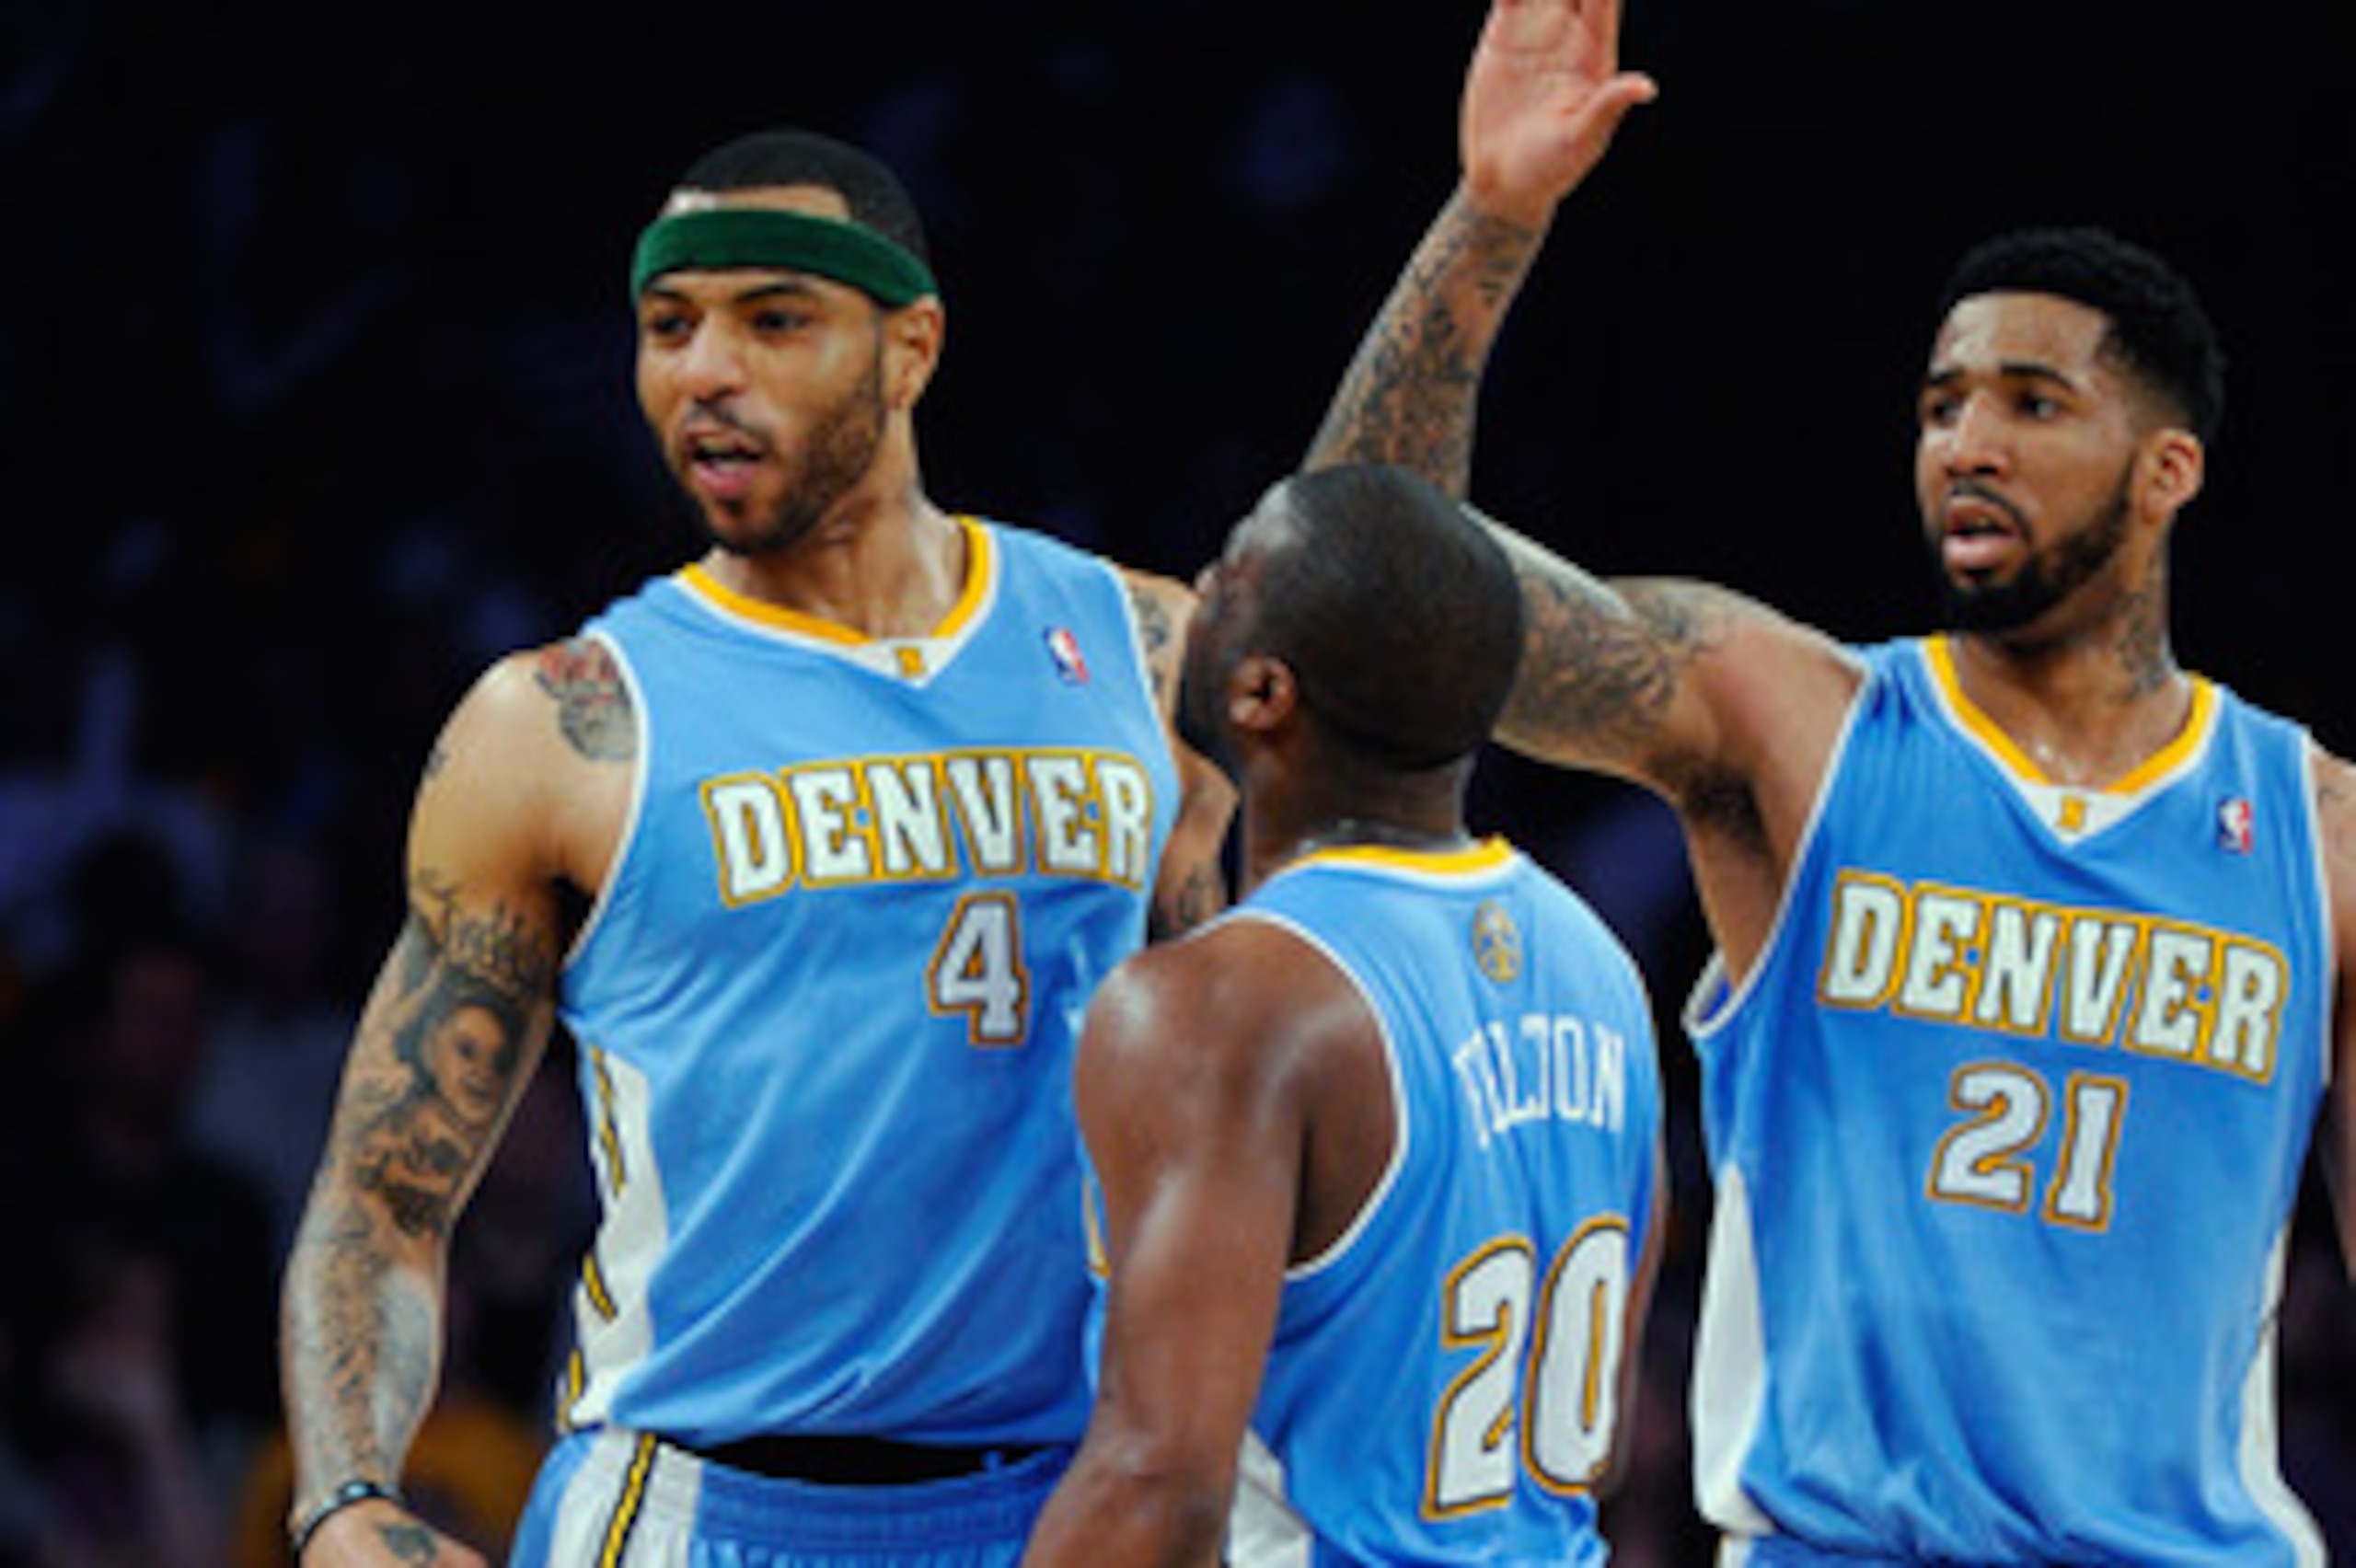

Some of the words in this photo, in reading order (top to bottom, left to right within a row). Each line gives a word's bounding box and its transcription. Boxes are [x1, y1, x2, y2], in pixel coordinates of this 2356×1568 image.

[701, 749, 1152, 905] DENVER
[929, 891, 1028, 1046] 4
[1819, 870, 2288, 1083] DENVER
[1930, 1062, 2128, 1230] 21
[1423, 1212, 1629, 1519] 20
